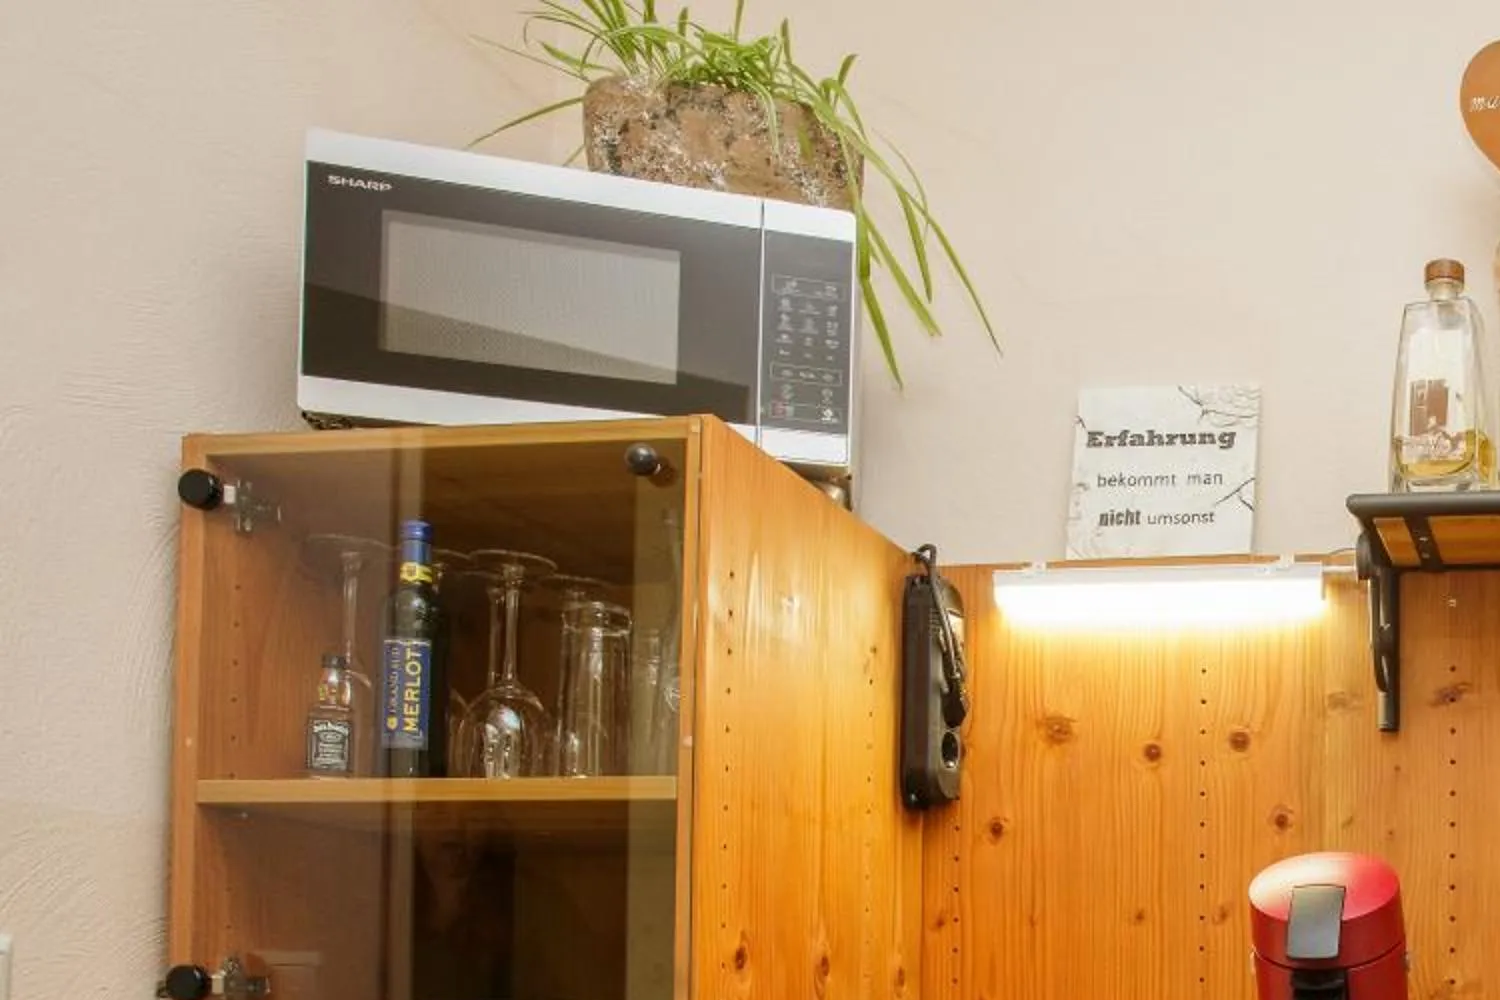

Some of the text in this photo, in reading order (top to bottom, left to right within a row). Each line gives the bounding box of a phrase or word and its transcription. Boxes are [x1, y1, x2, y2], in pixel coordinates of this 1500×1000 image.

[328, 174, 393, 191] SHARP
[1086, 429, 1236, 449] Erfahrung
[1097, 472, 1223, 488] bekommt man
[1099, 508, 1215, 526] nicht umsonst
[403, 647, 421, 732] MERLOT
